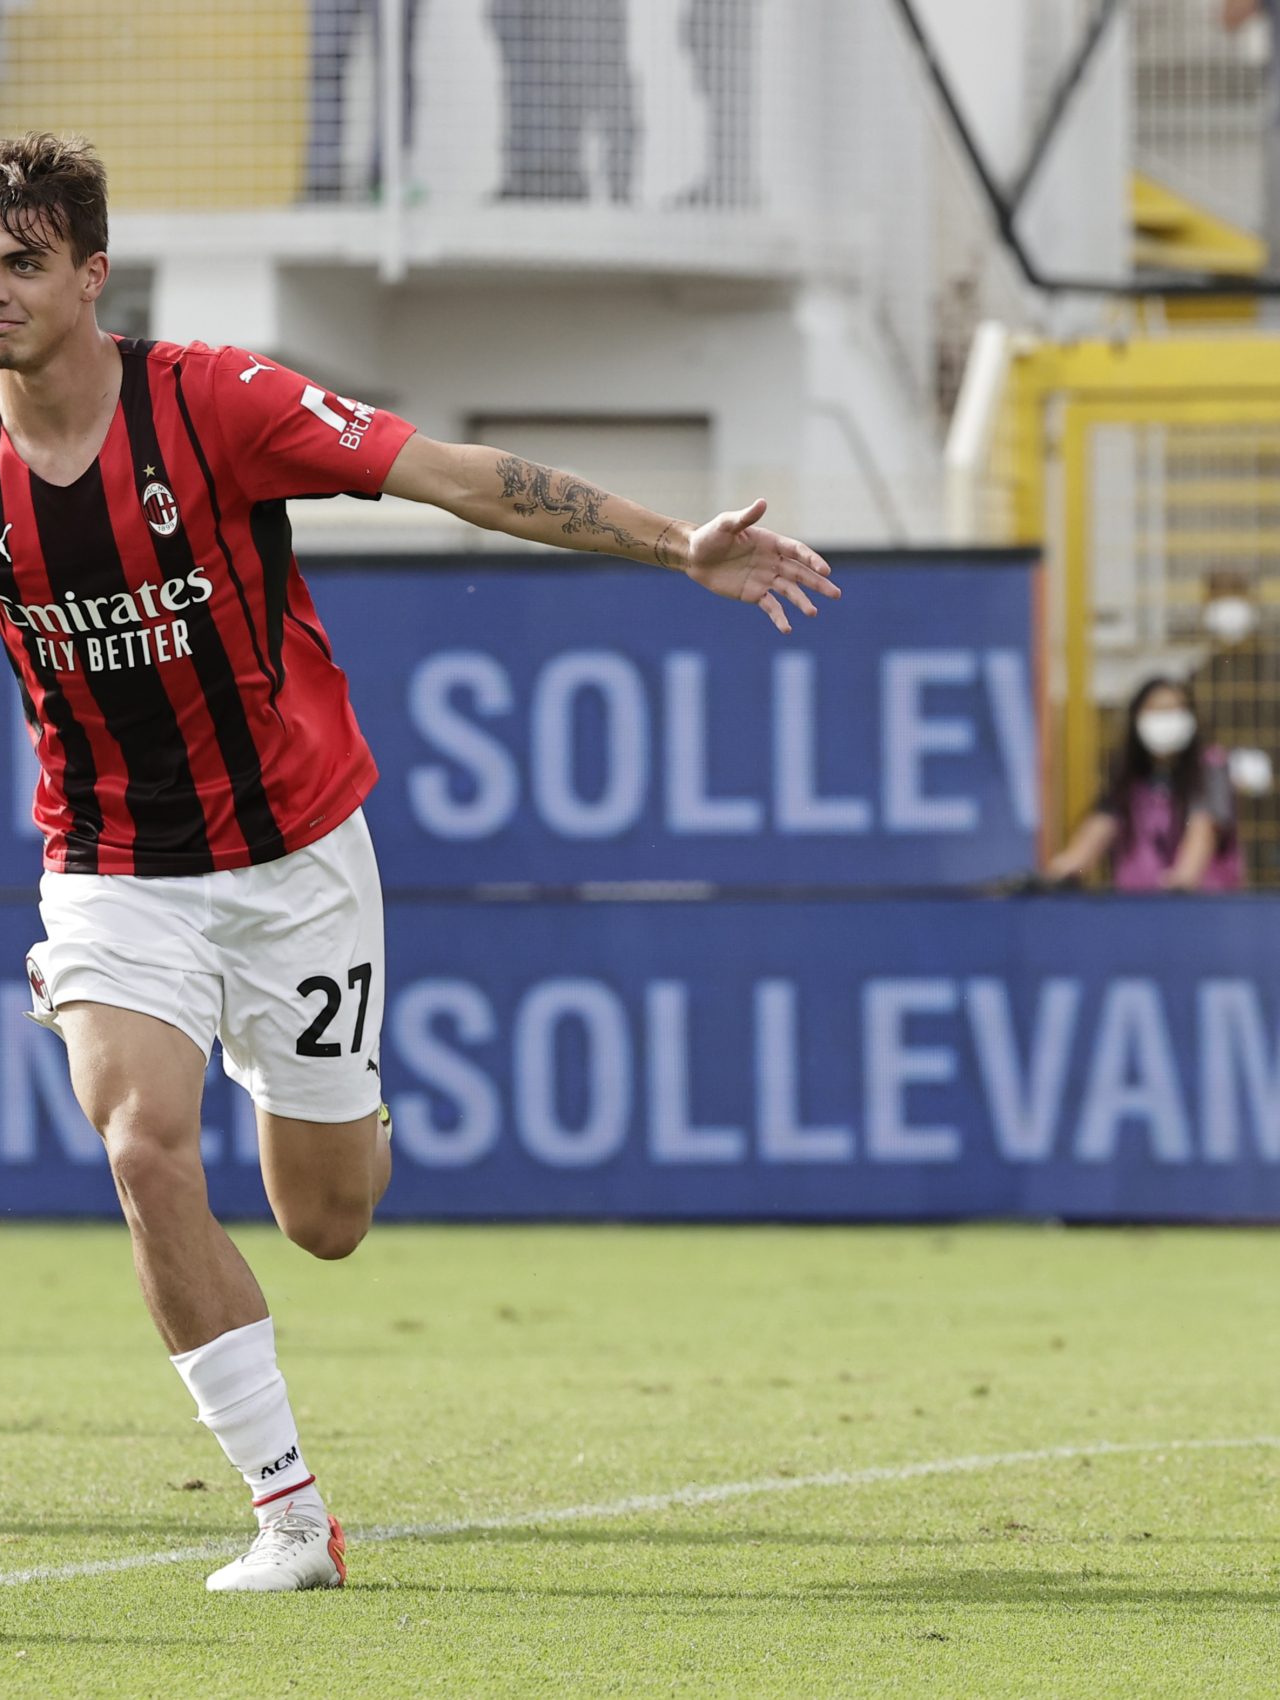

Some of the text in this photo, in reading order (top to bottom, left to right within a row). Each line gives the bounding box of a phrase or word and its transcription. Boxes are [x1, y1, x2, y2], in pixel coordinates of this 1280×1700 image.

[338, 401, 376, 451] BitM
[146, 484, 167, 496] ACM
[157, 521, 176, 533] 1899
[35, 618, 194, 673] FLY BETTER
[295, 962, 372, 1058] 27
[261, 1445, 299, 1480] ACM
